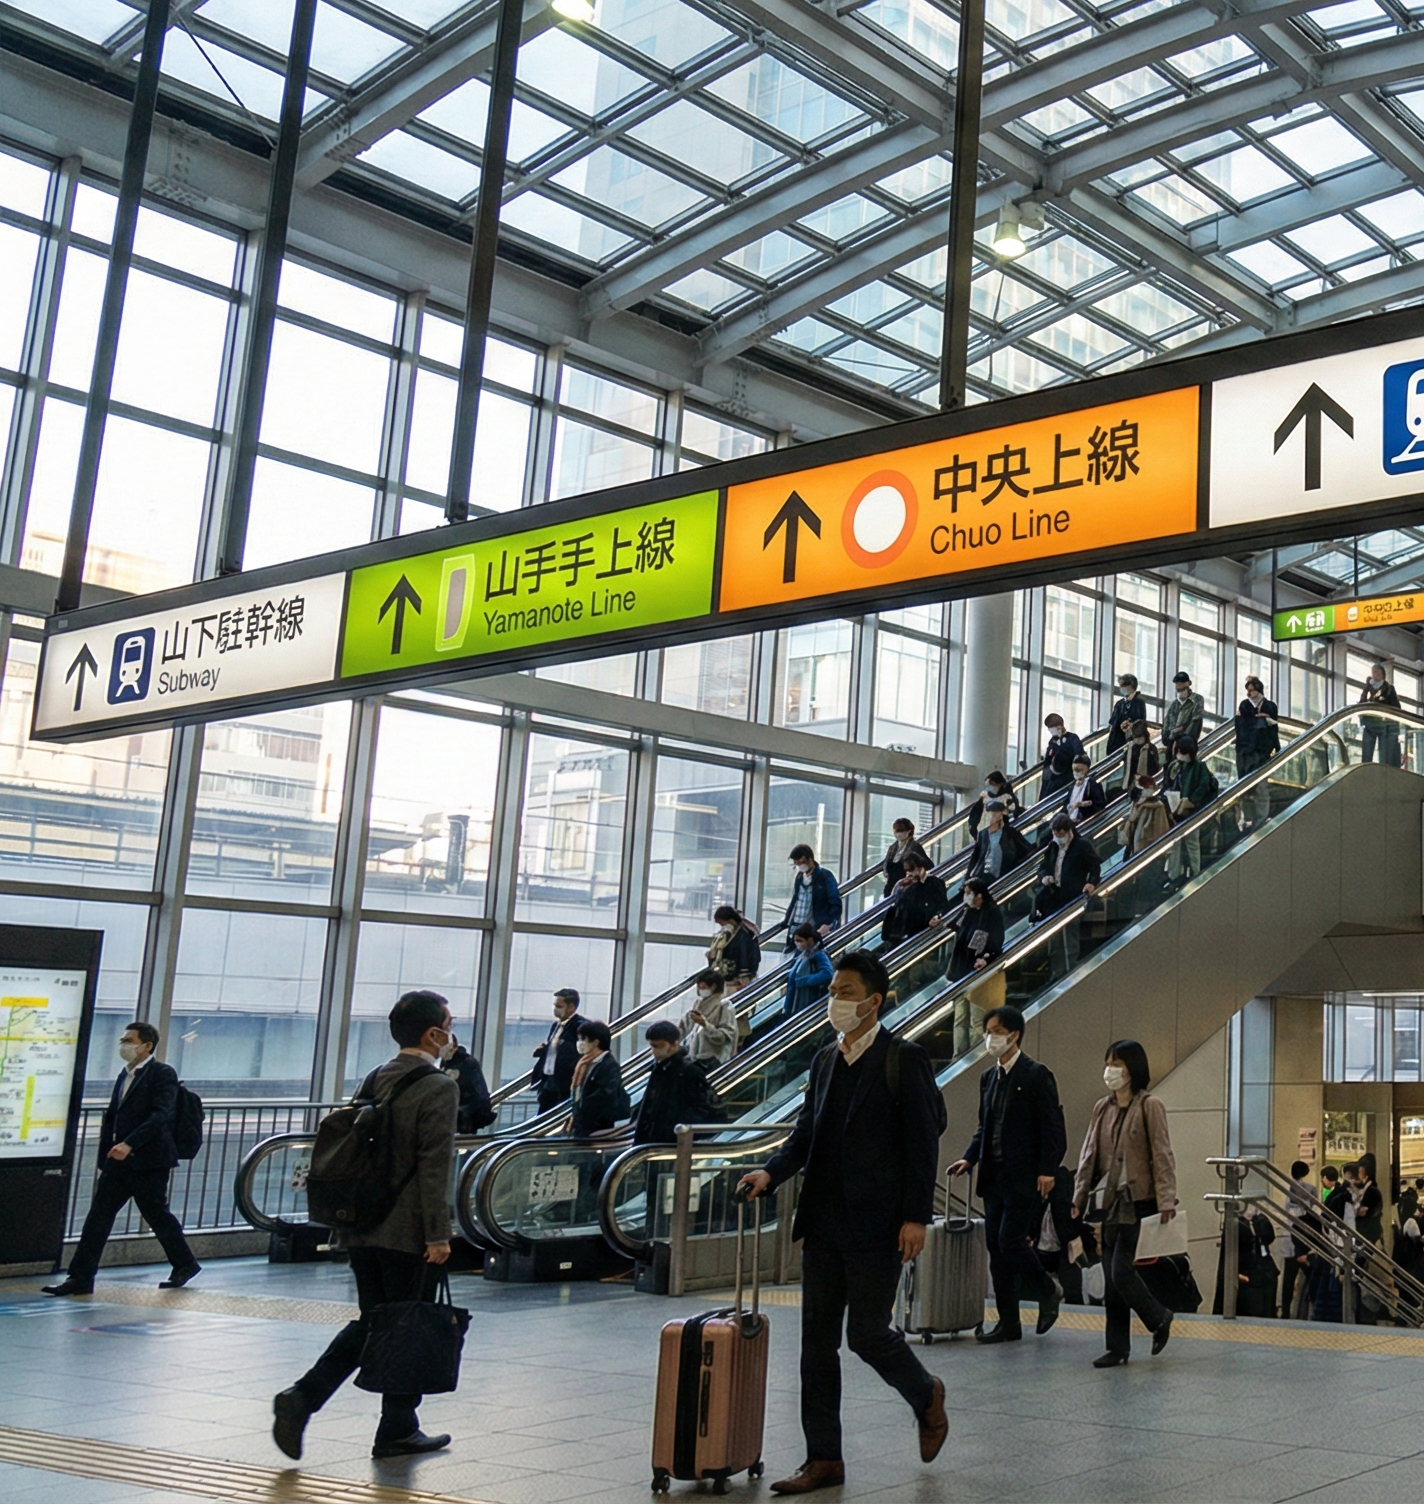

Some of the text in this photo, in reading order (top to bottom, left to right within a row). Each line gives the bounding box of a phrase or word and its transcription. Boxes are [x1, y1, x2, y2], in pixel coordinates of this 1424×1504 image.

[932, 418, 1141, 514] 中央上線
[930, 507, 1071, 555] Chuo Line
[484, 516, 676, 602] 山手手上線
[483, 588, 636, 635] Yamanote Line
[157, 667, 221, 695] Subway
